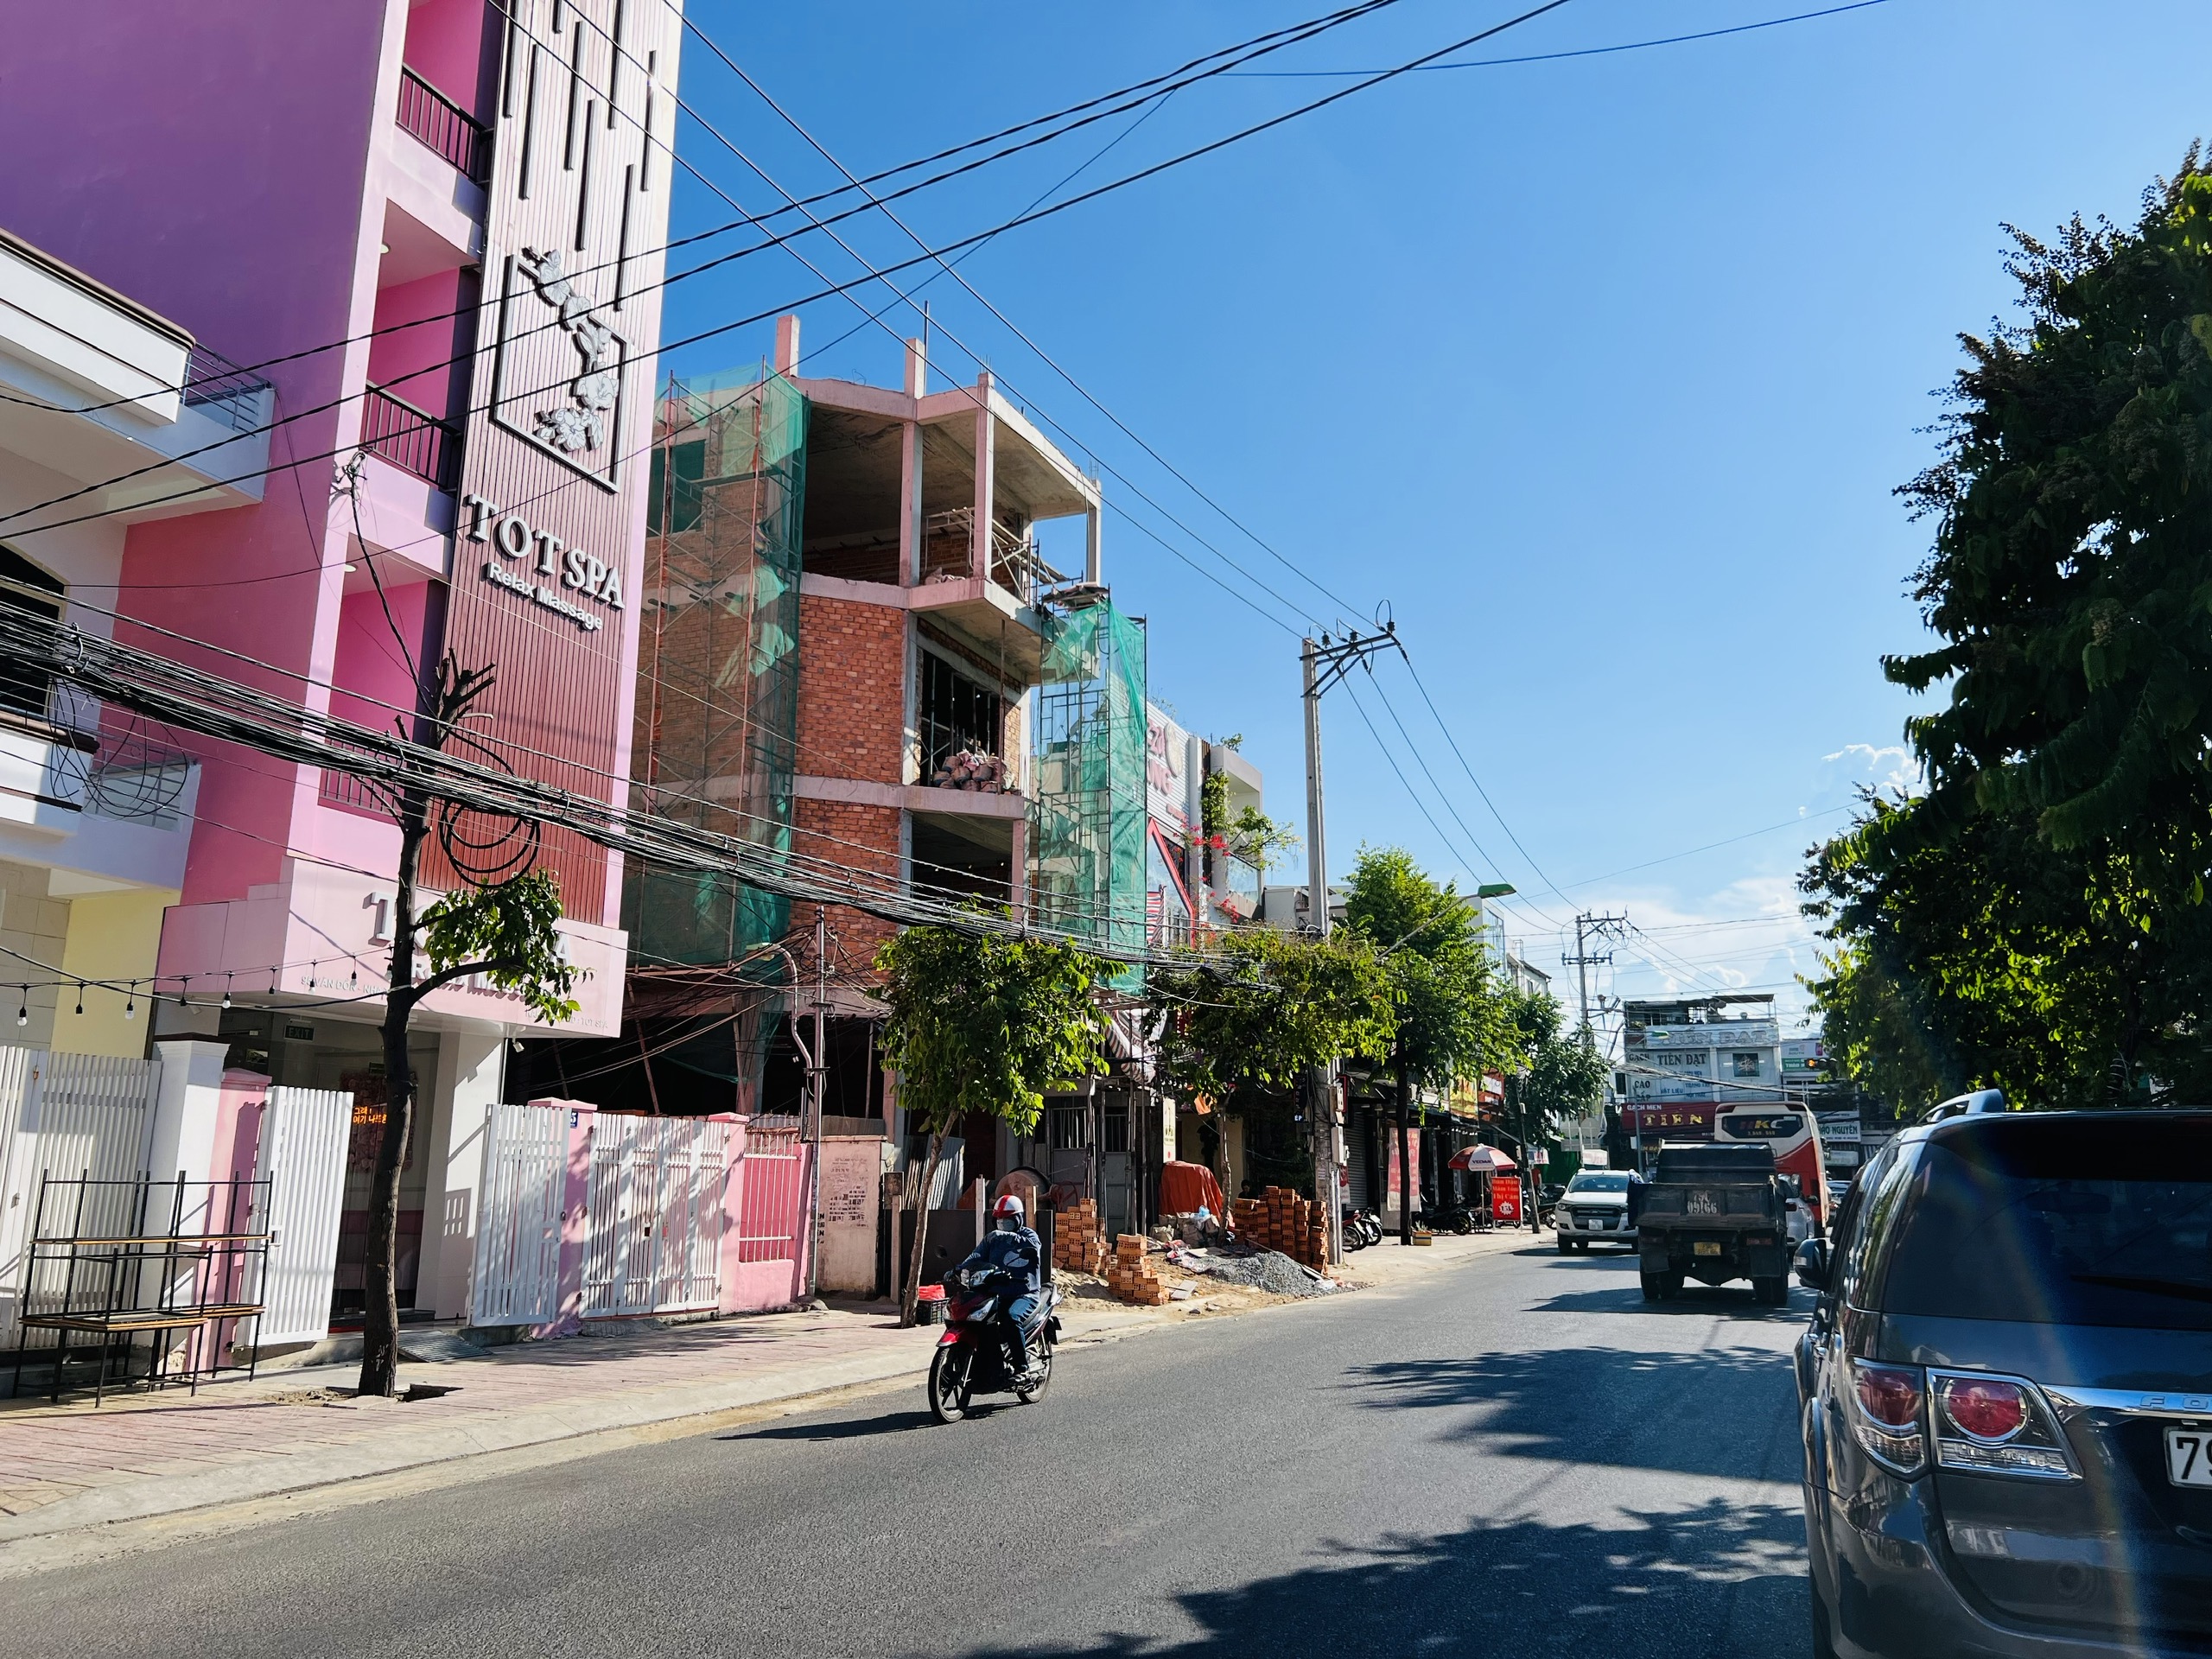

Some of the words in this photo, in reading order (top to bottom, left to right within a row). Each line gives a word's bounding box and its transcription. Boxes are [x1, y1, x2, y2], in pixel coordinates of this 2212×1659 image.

[469, 493, 564, 576] TOT
[565, 548, 625, 610] SPA
[488, 562, 535, 599] Relax
[537, 586, 603, 631] Massage
[288, 1027, 310, 1039] EXIT
[1634, 1080, 1650, 1089] CAO
